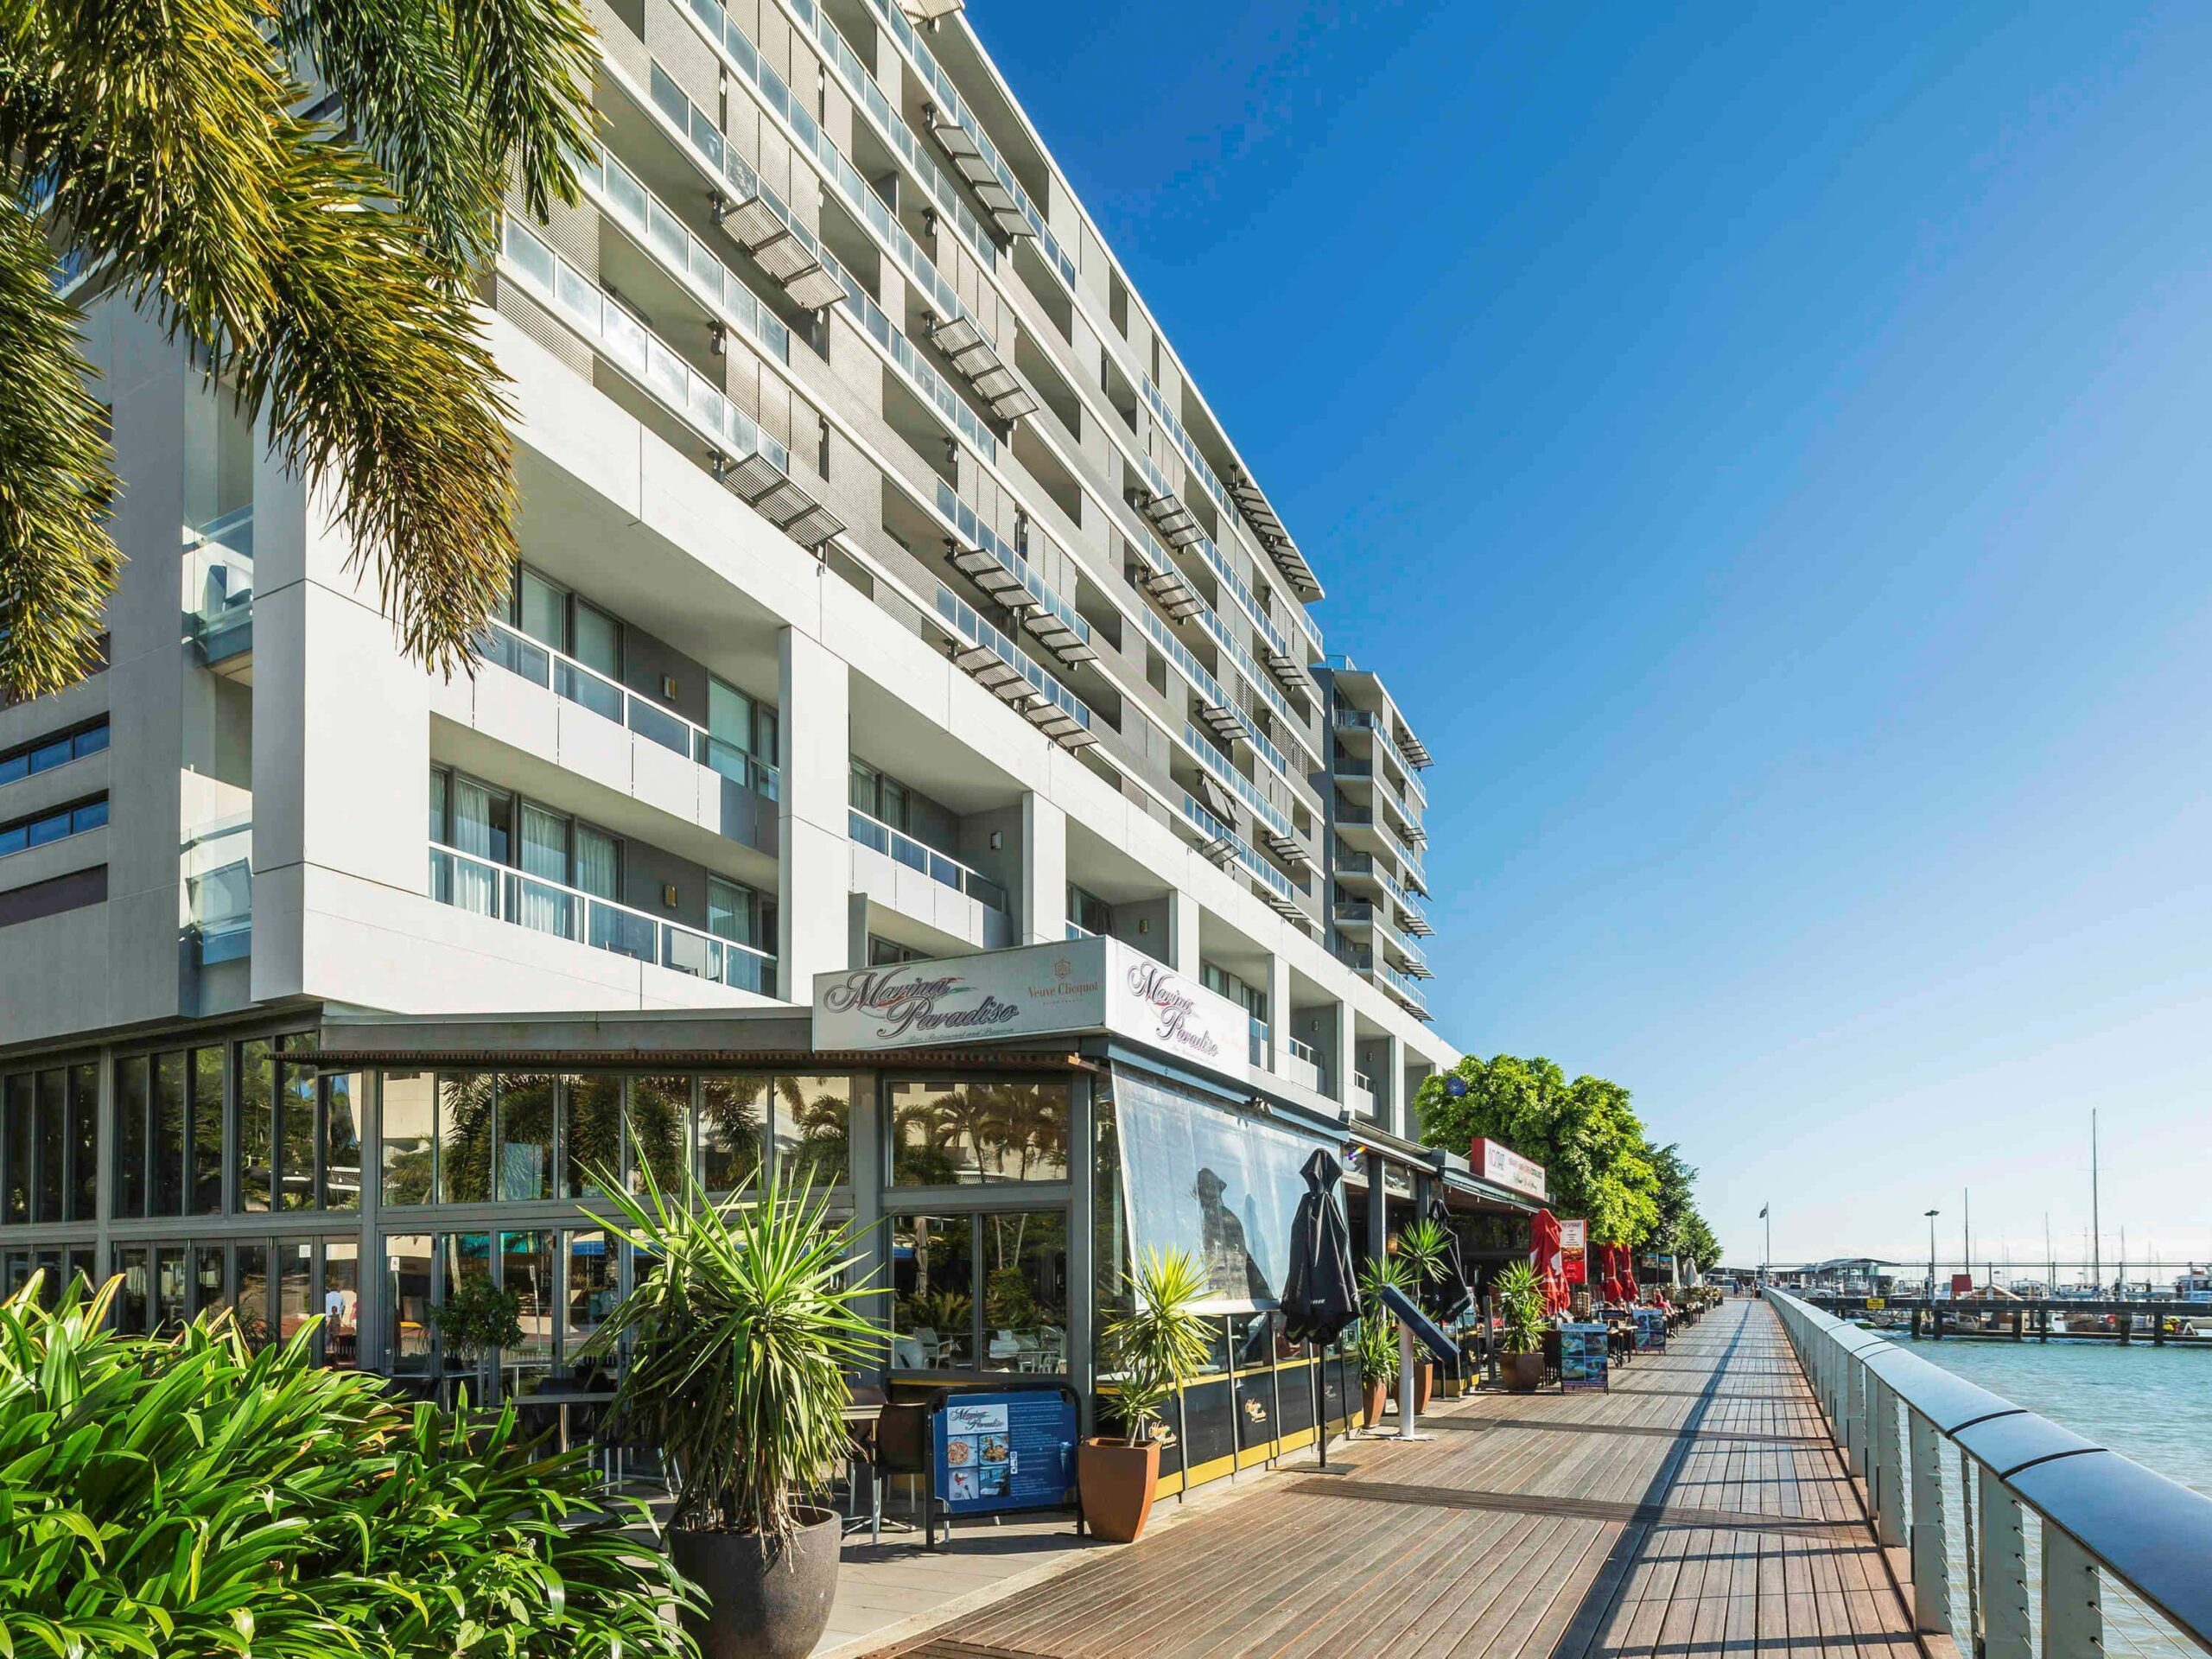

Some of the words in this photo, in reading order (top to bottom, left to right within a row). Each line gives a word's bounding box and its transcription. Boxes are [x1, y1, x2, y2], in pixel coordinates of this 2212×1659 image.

[823, 966, 951, 1013] Marina
[1028, 986, 1055, 998] Veuve
[1058, 982, 1098, 995] Clicquot
[1128, 962, 1193, 1014] Marina
[877, 995, 1020, 1039] Paradiso
[1156, 1006, 1218, 1057] Paradiso
